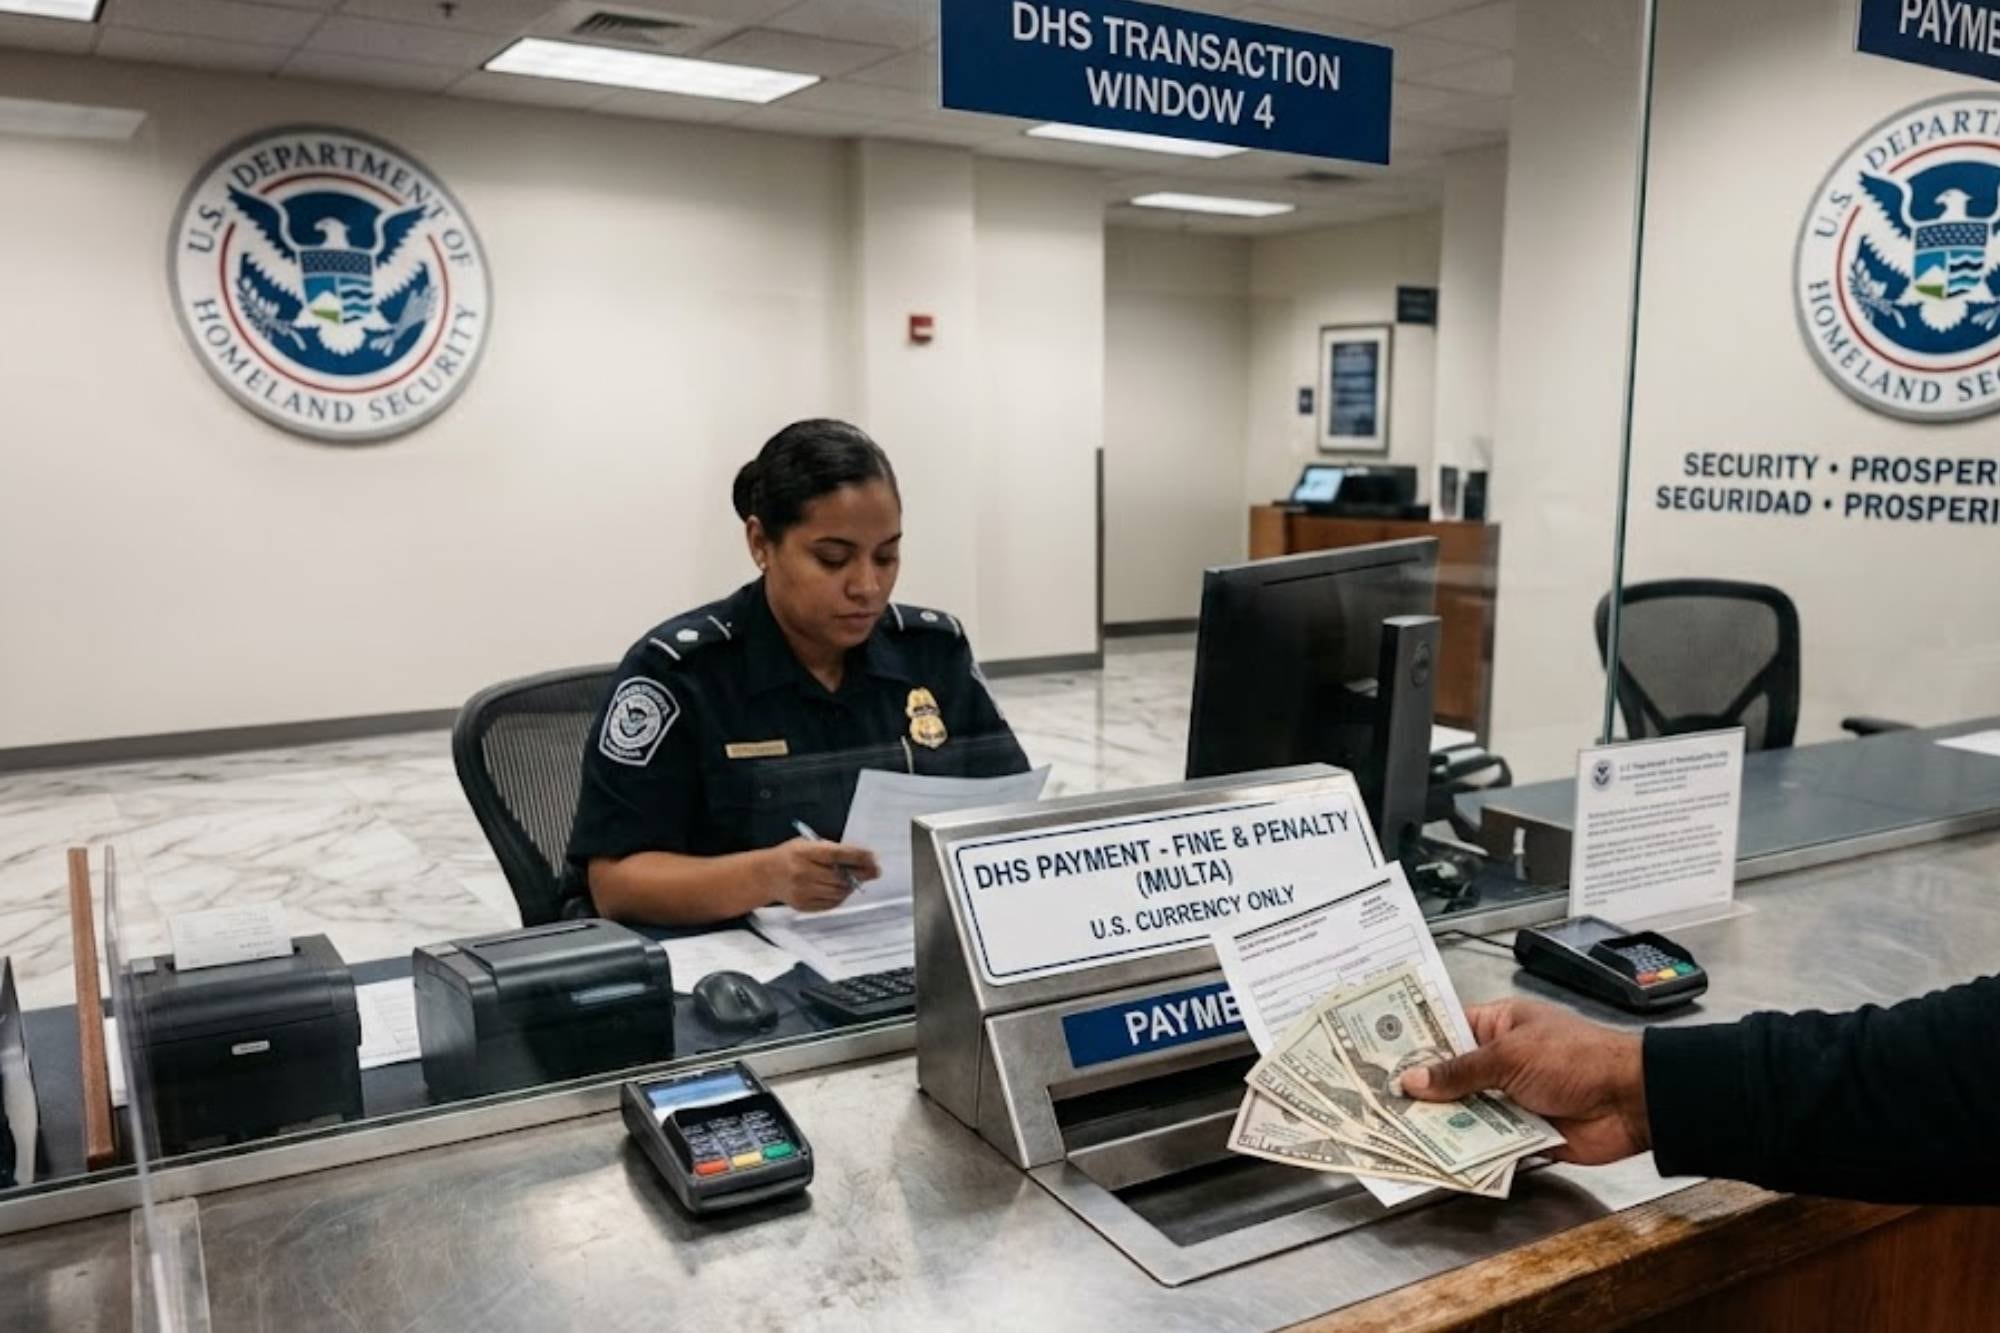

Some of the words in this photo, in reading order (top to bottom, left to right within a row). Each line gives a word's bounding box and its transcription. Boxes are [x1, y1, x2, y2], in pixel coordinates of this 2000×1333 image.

[1013, 2, 1092, 50] DHS
[1103, 15, 1340, 90] TRANSACTION
[1086, 67, 1245, 126] WINDOW
[1254, 94, 1275, 129] 4
[1865, 109, 2000, 171] DEPART
[232, 142, 445, 219] DEPARTMENT
[443, 229, 474, 266] OF
[194, 298, 355, 423] HOMELAND
[368, 303, 477, 421] SECURITY
[1809, 281, 1942, 403] HOMELAND
[1956, 364, 2000, 402] SE
[1684, 453, 1819, 480] SECURITY
[1851, 456, 1997, 486] PROSPER
[1656, 486, 1812, 516] SEGURIDAD
[1844, 493, 1999, 525] PROSPERI
[974, 858, 1031, 890] DHS
[1036, 839, 1151, 879] PAYMENT
[1172, 828, 1227, 857] FINE
[1232, 826, 1249, 849] &
[1252, 810, 1349, 845] PENALTY
[1136, 858, 1234, 900] (MULTA)
[1089, 916, 1132, 940] U.S.
[1135, 895, 1241, 932] CURRENCY
[1247, 885, 1295, 911] ONLY
[1124, 990, 1244, 1046] PAYME
